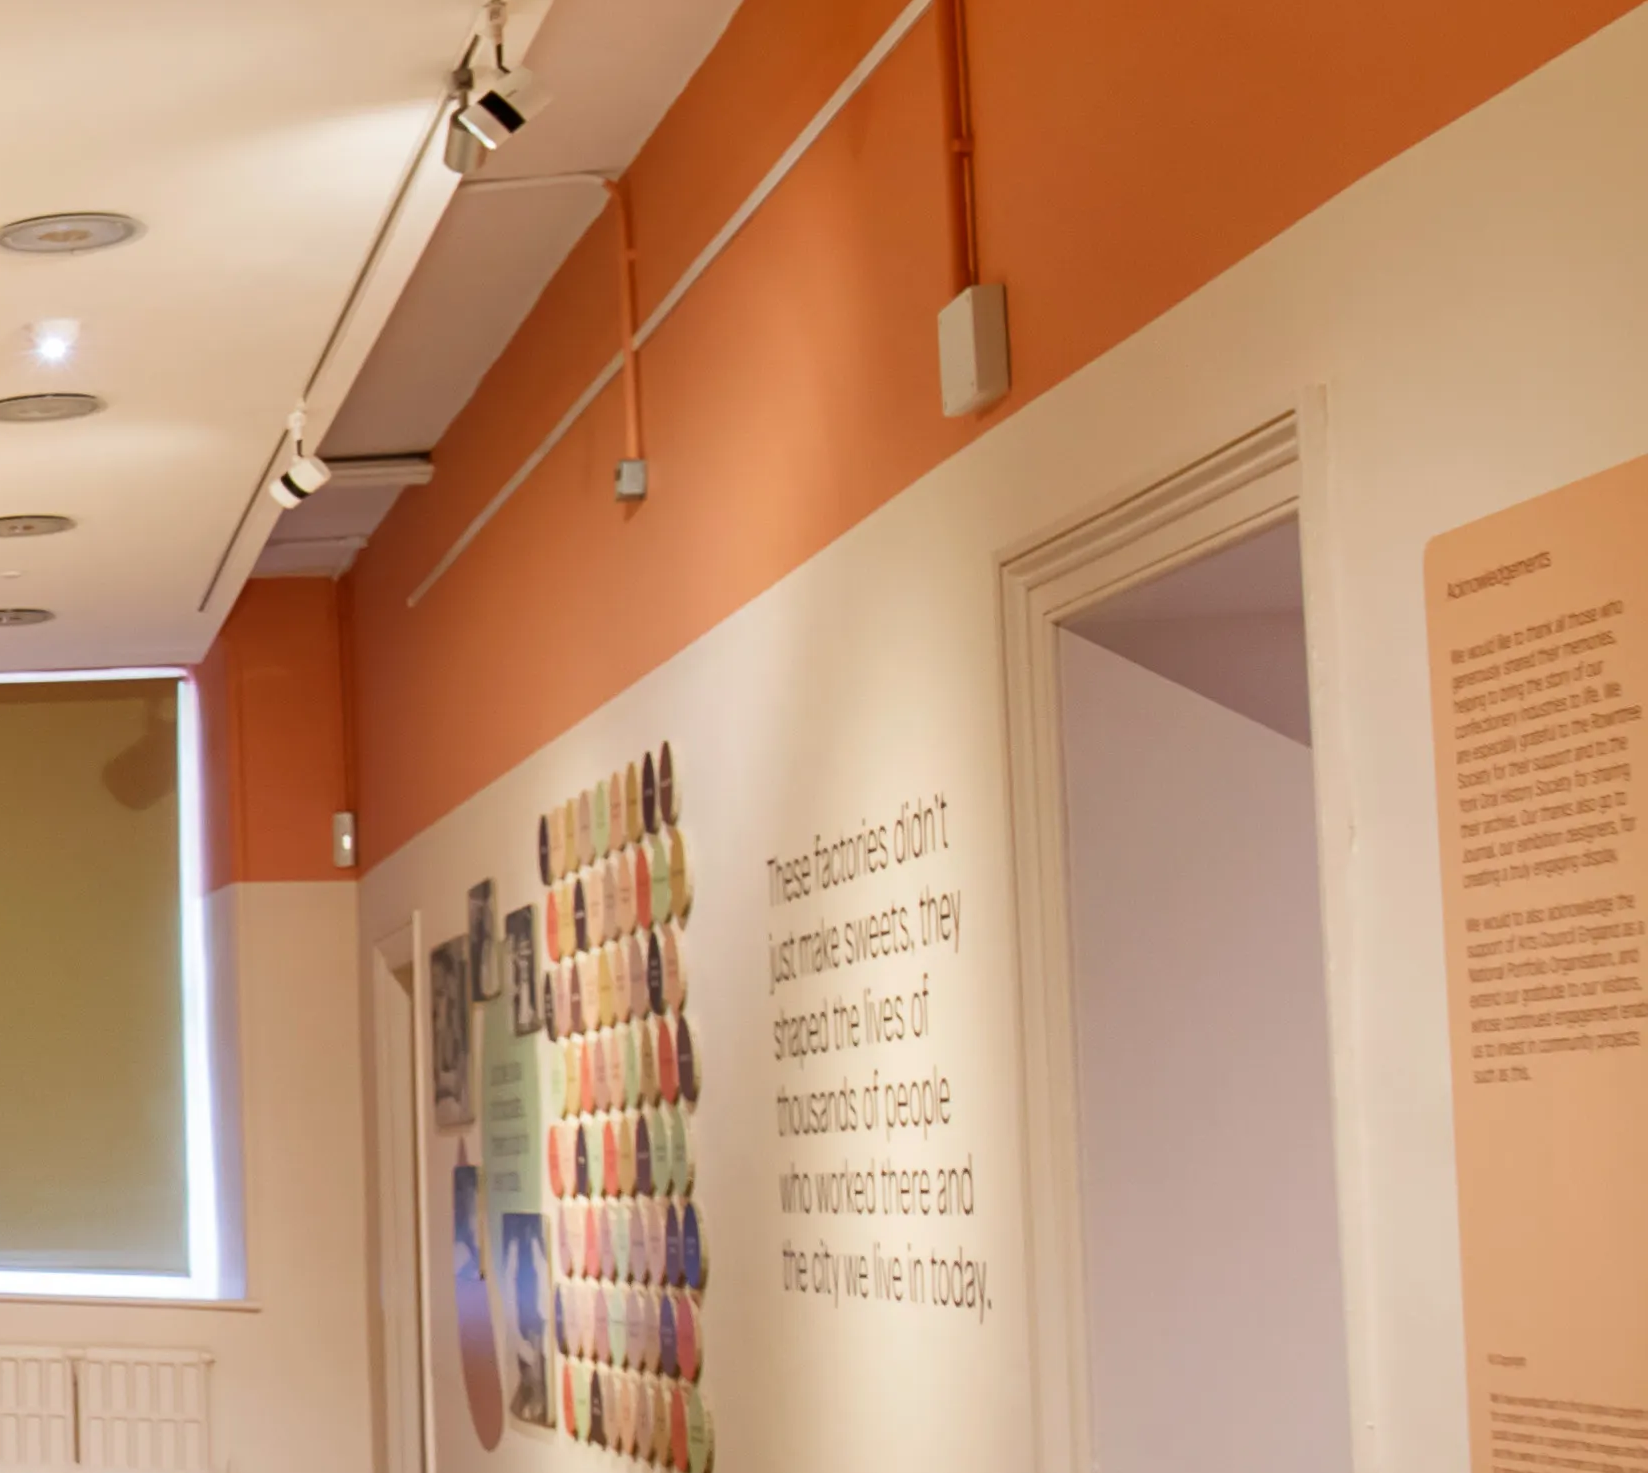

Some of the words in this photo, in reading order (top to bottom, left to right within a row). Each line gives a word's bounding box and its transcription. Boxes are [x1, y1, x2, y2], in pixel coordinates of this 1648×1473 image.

[767, 856, 811, 907] These
[814, 818, 889, 890] factories
[894, 791, 949, 864] didn't
[769, 932, 797, 996] just
[799, 917, 840, 972] make
[845, 903, 915, 965] sweets,
[919, 884, 961, 954] they
[774, 996, 828, 1070] shaped
[833, 994, 860, 1050] the
[864, 987, 904, 1044] lives
[911, 972, 929, 1037] of
[777, 1076, 858, 1137] thousands
[863, 1069, 879, 1130] of
[885, 1064, 951, 1143] people
[779, 1162, 812, 1214] who
[815, 1158, 876, 1215] worked
[881, 1157, 931, 1215] there
[938, 1152, 974, 1215] and
[783, 1240, 807, 1292] the
[813, 1239, 840, 1308] city
[841, 1254, 868, 1299] we
[873, 1241, 903, 1301] live
[908, 1242, 925, 1303] in
[931, 1245, 992, 1324] today.
